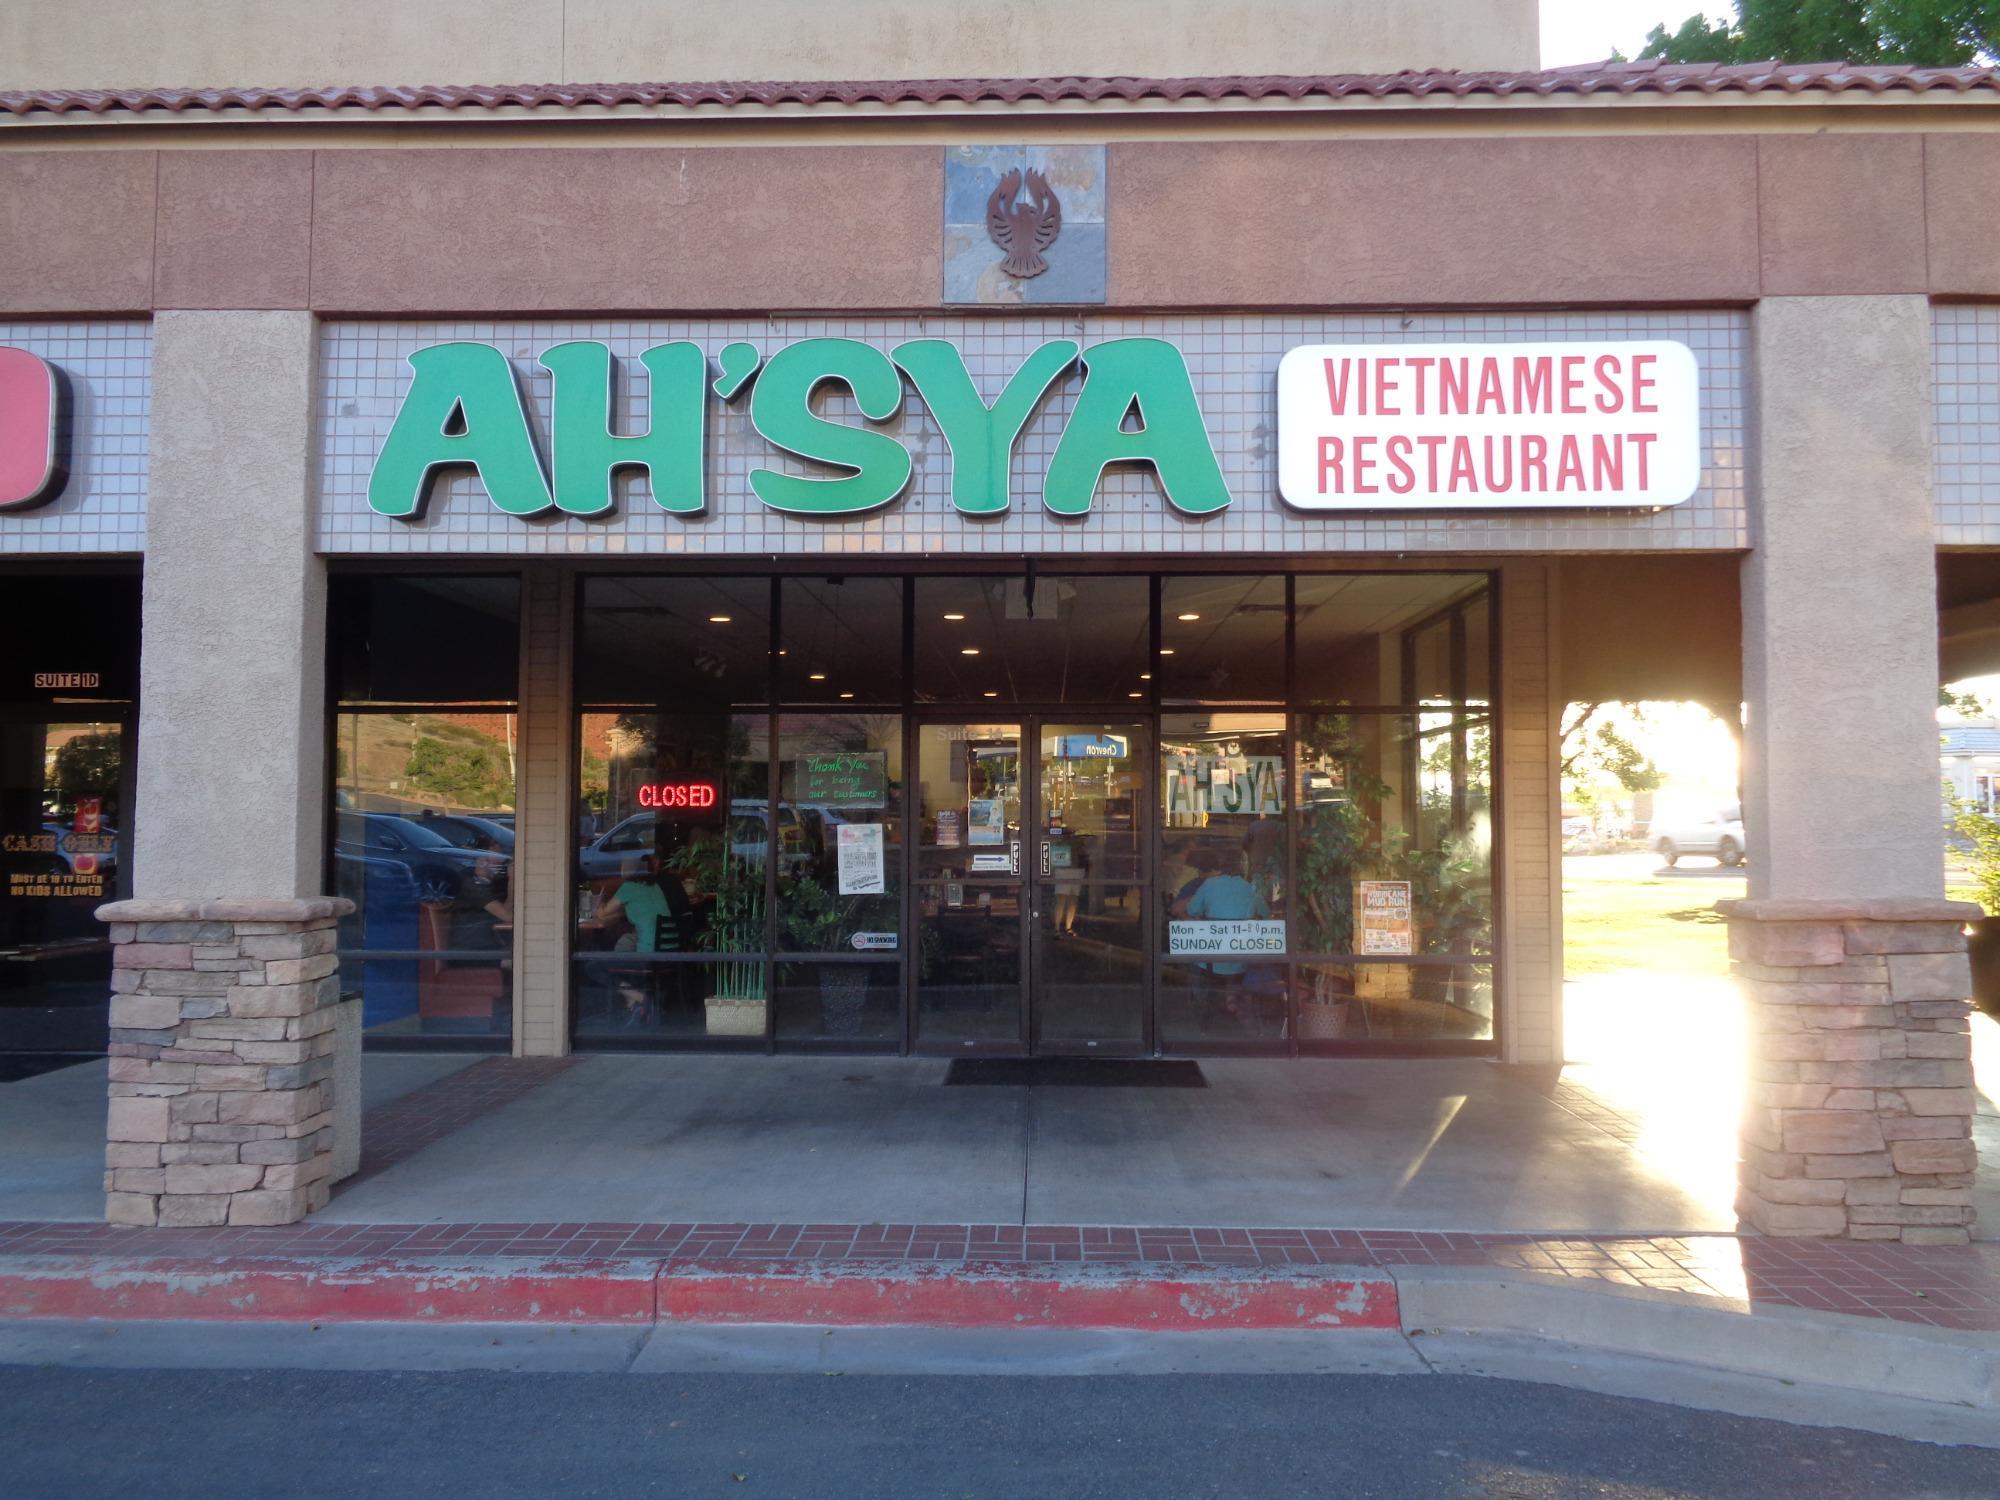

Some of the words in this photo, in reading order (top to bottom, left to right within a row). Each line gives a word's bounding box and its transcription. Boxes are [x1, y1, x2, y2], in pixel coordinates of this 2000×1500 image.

[1323, 354, 1658, 416] VIETNAMESE
[367, 337, 1233, 518] AH'SYA
[1317, 433, 1657, 494] RESTAURANT
[35, 673, 79, 687] SUITE
[937, 728, 977, 741] Suite
[639, 785, 714, 807] CLOSED
[1, 834, 56, 852] CASH
[10, 874, 34, 884] MUST
[75, 874, 103, 884] ENTER
[10, 886, 24, 896] NO
[26, 886, 51, 896] KIDS
[53, 886, 102, 896] ALLOWED
[1171, 925, 1194, 935] Mon
[1210, 924, 1229, 935] Sat
[1171, 938, 1222, 950] SUNDAY
[1229, 938, 1283, 950] CLOSED
